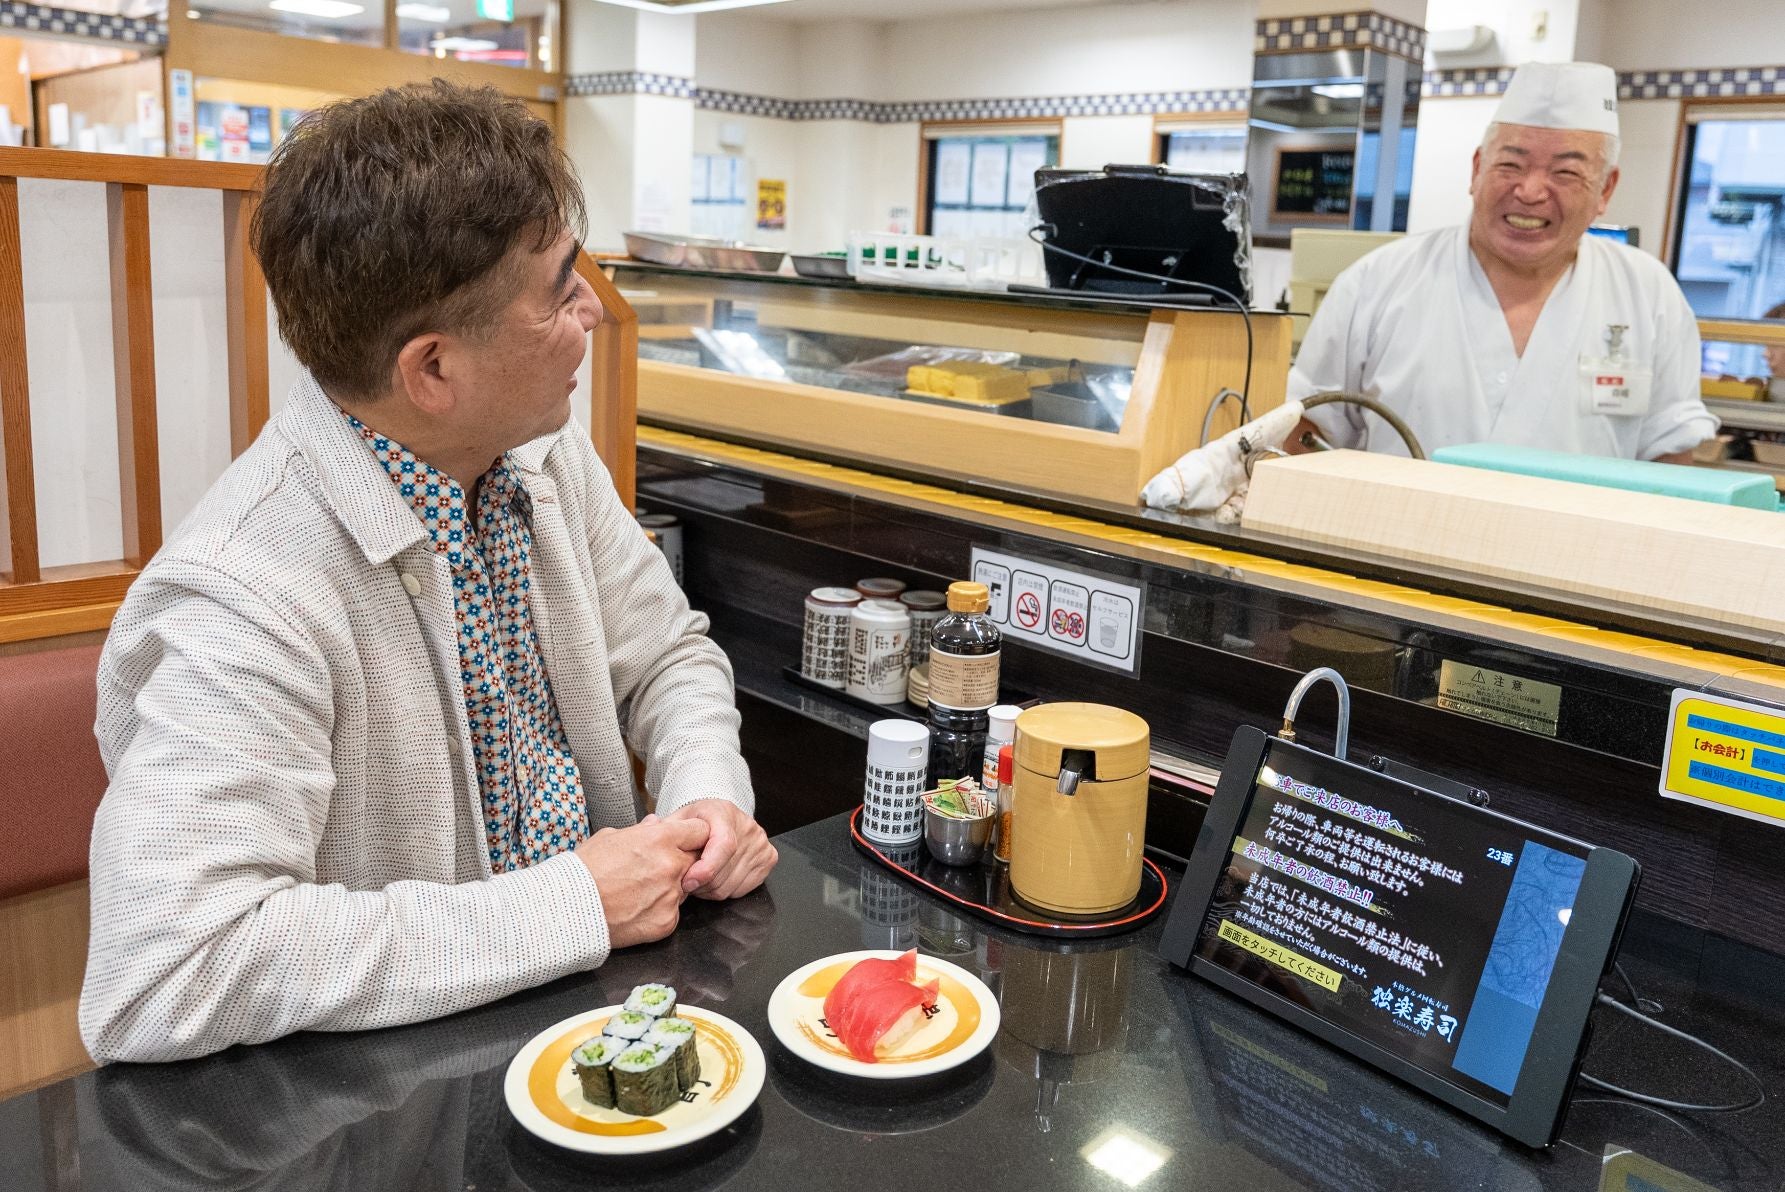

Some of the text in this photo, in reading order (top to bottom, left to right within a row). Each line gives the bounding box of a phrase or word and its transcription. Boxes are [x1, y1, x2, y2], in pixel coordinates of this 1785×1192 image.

[1270, 774, 1404, 832] 車でご来店のお客様へ
[1486, 847, 1514, 867] 23番
[1239, 899, 1316, 943] 一切しておりません。
[1222, 925, 1336, 986] 画面をタッチしてください
[1370, 985, 1459, 1044] 独楽寿司
[1392, 1018, 1427, 1038] KOMAZUSHI
